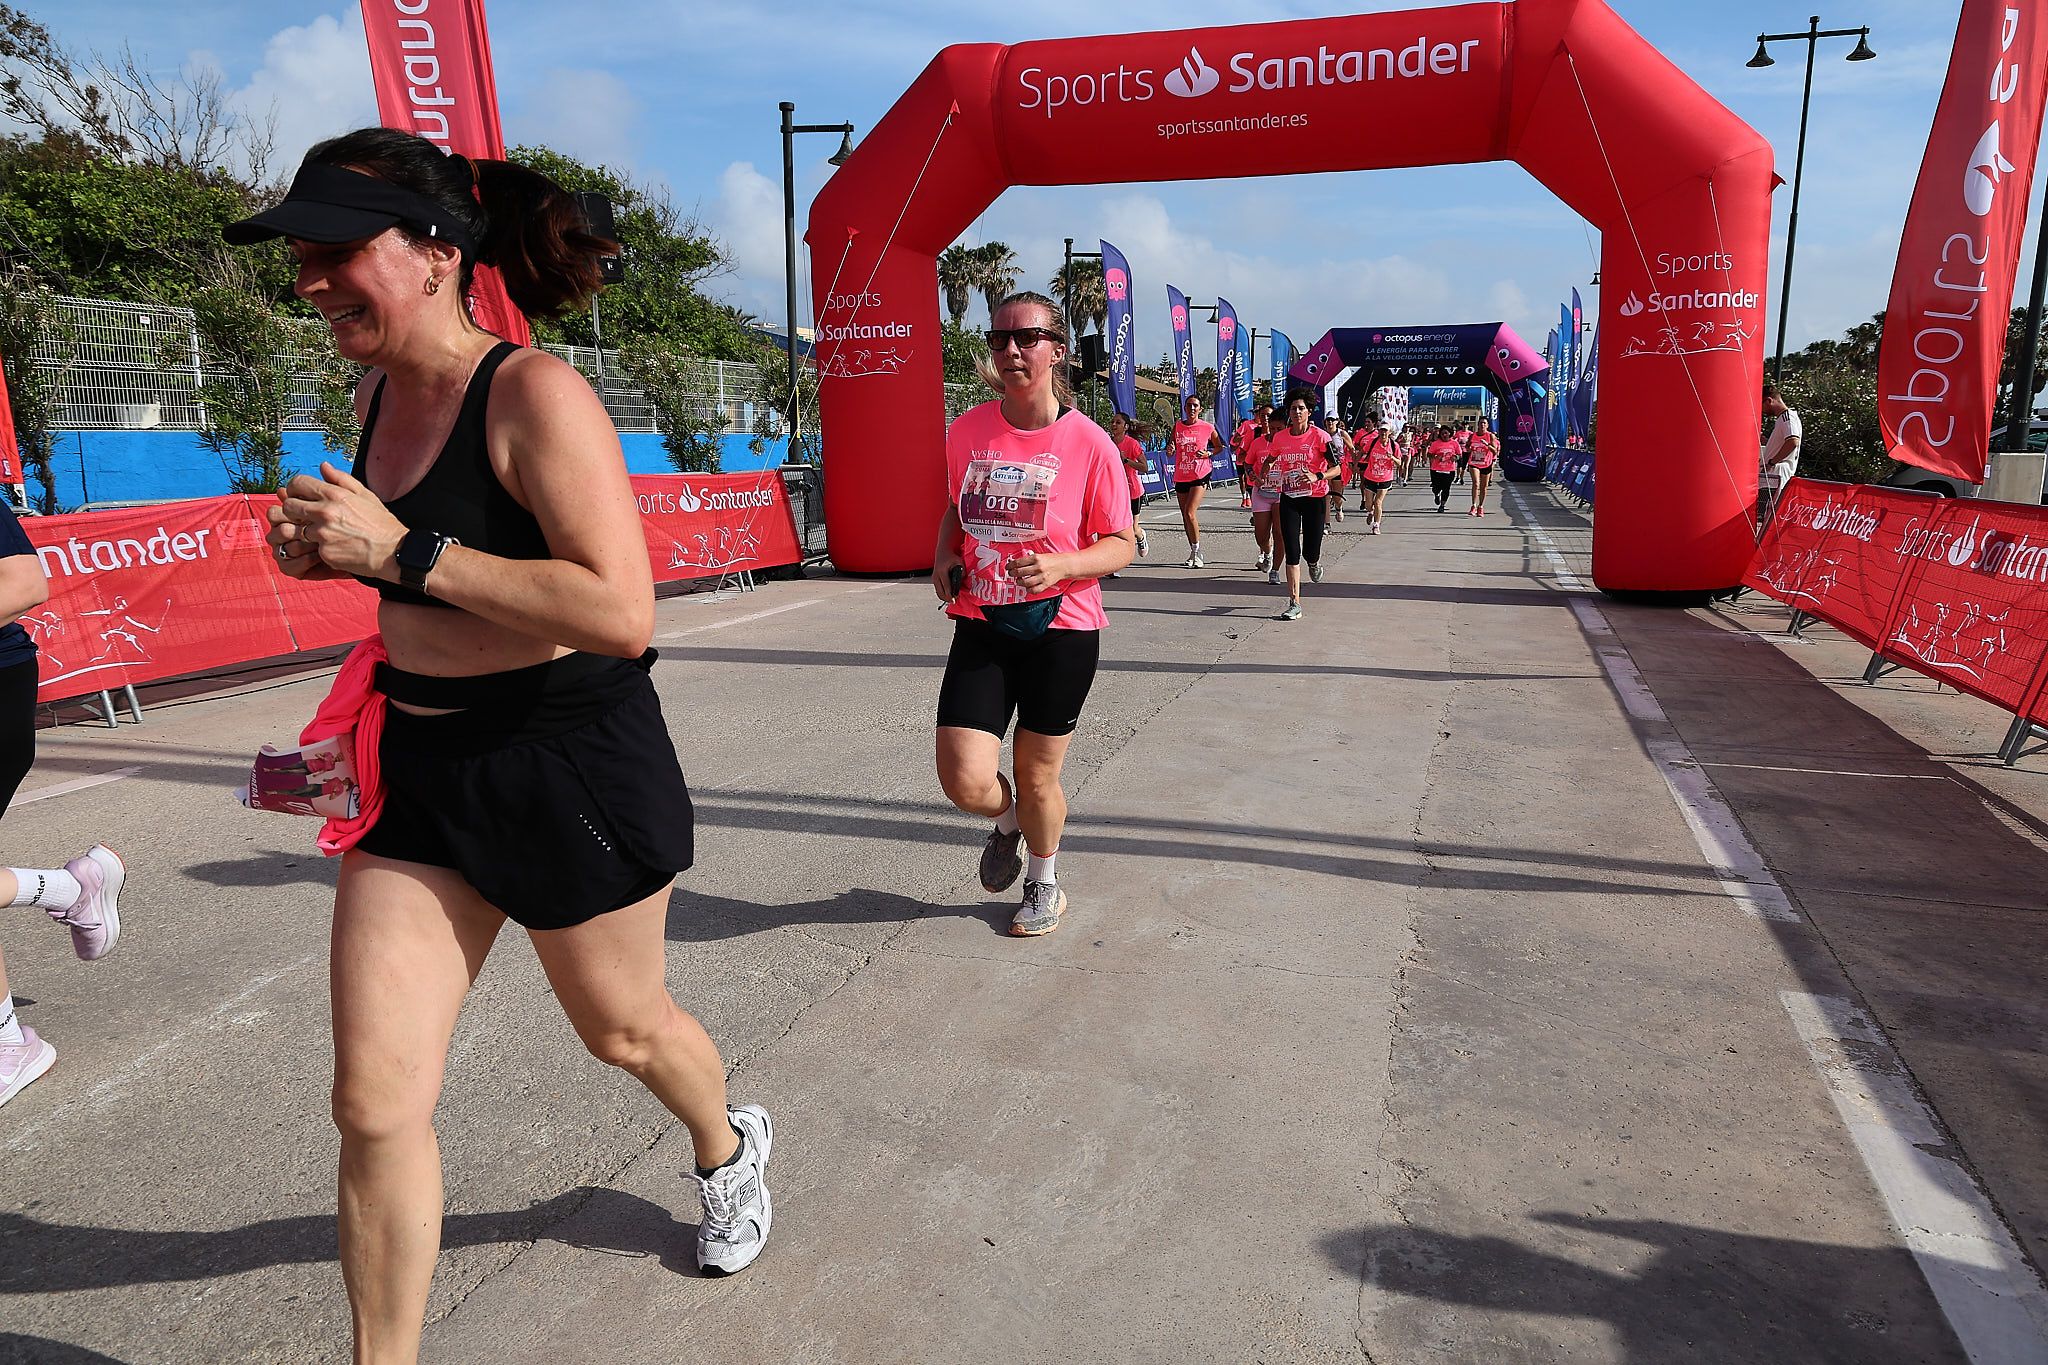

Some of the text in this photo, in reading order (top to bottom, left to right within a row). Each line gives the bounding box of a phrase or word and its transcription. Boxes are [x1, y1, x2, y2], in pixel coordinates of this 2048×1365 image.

[1018, 36, 1480, 119] Sports Santander
[1157, 112, 1309, 139] sportssantander.es
[1657, 251, 1733, 278] Sports
[828, 291, 881, 313] Sports
[1648, 288, 1759, 313] Santander
[825, 321, 913, 341] Santander
[1384, 333, 1457, 344] octopus energy
[1377, 346, 1407, 354] ENERGÍA
[1388, 366, 1475, 376] VOLVO
[1433, 388, 1467, 403] Marlene
[634, 485, 773, 514] orts Santander
[985, 495, 1019, 511] 016
[1895, 517, 1952, 564] Sports
